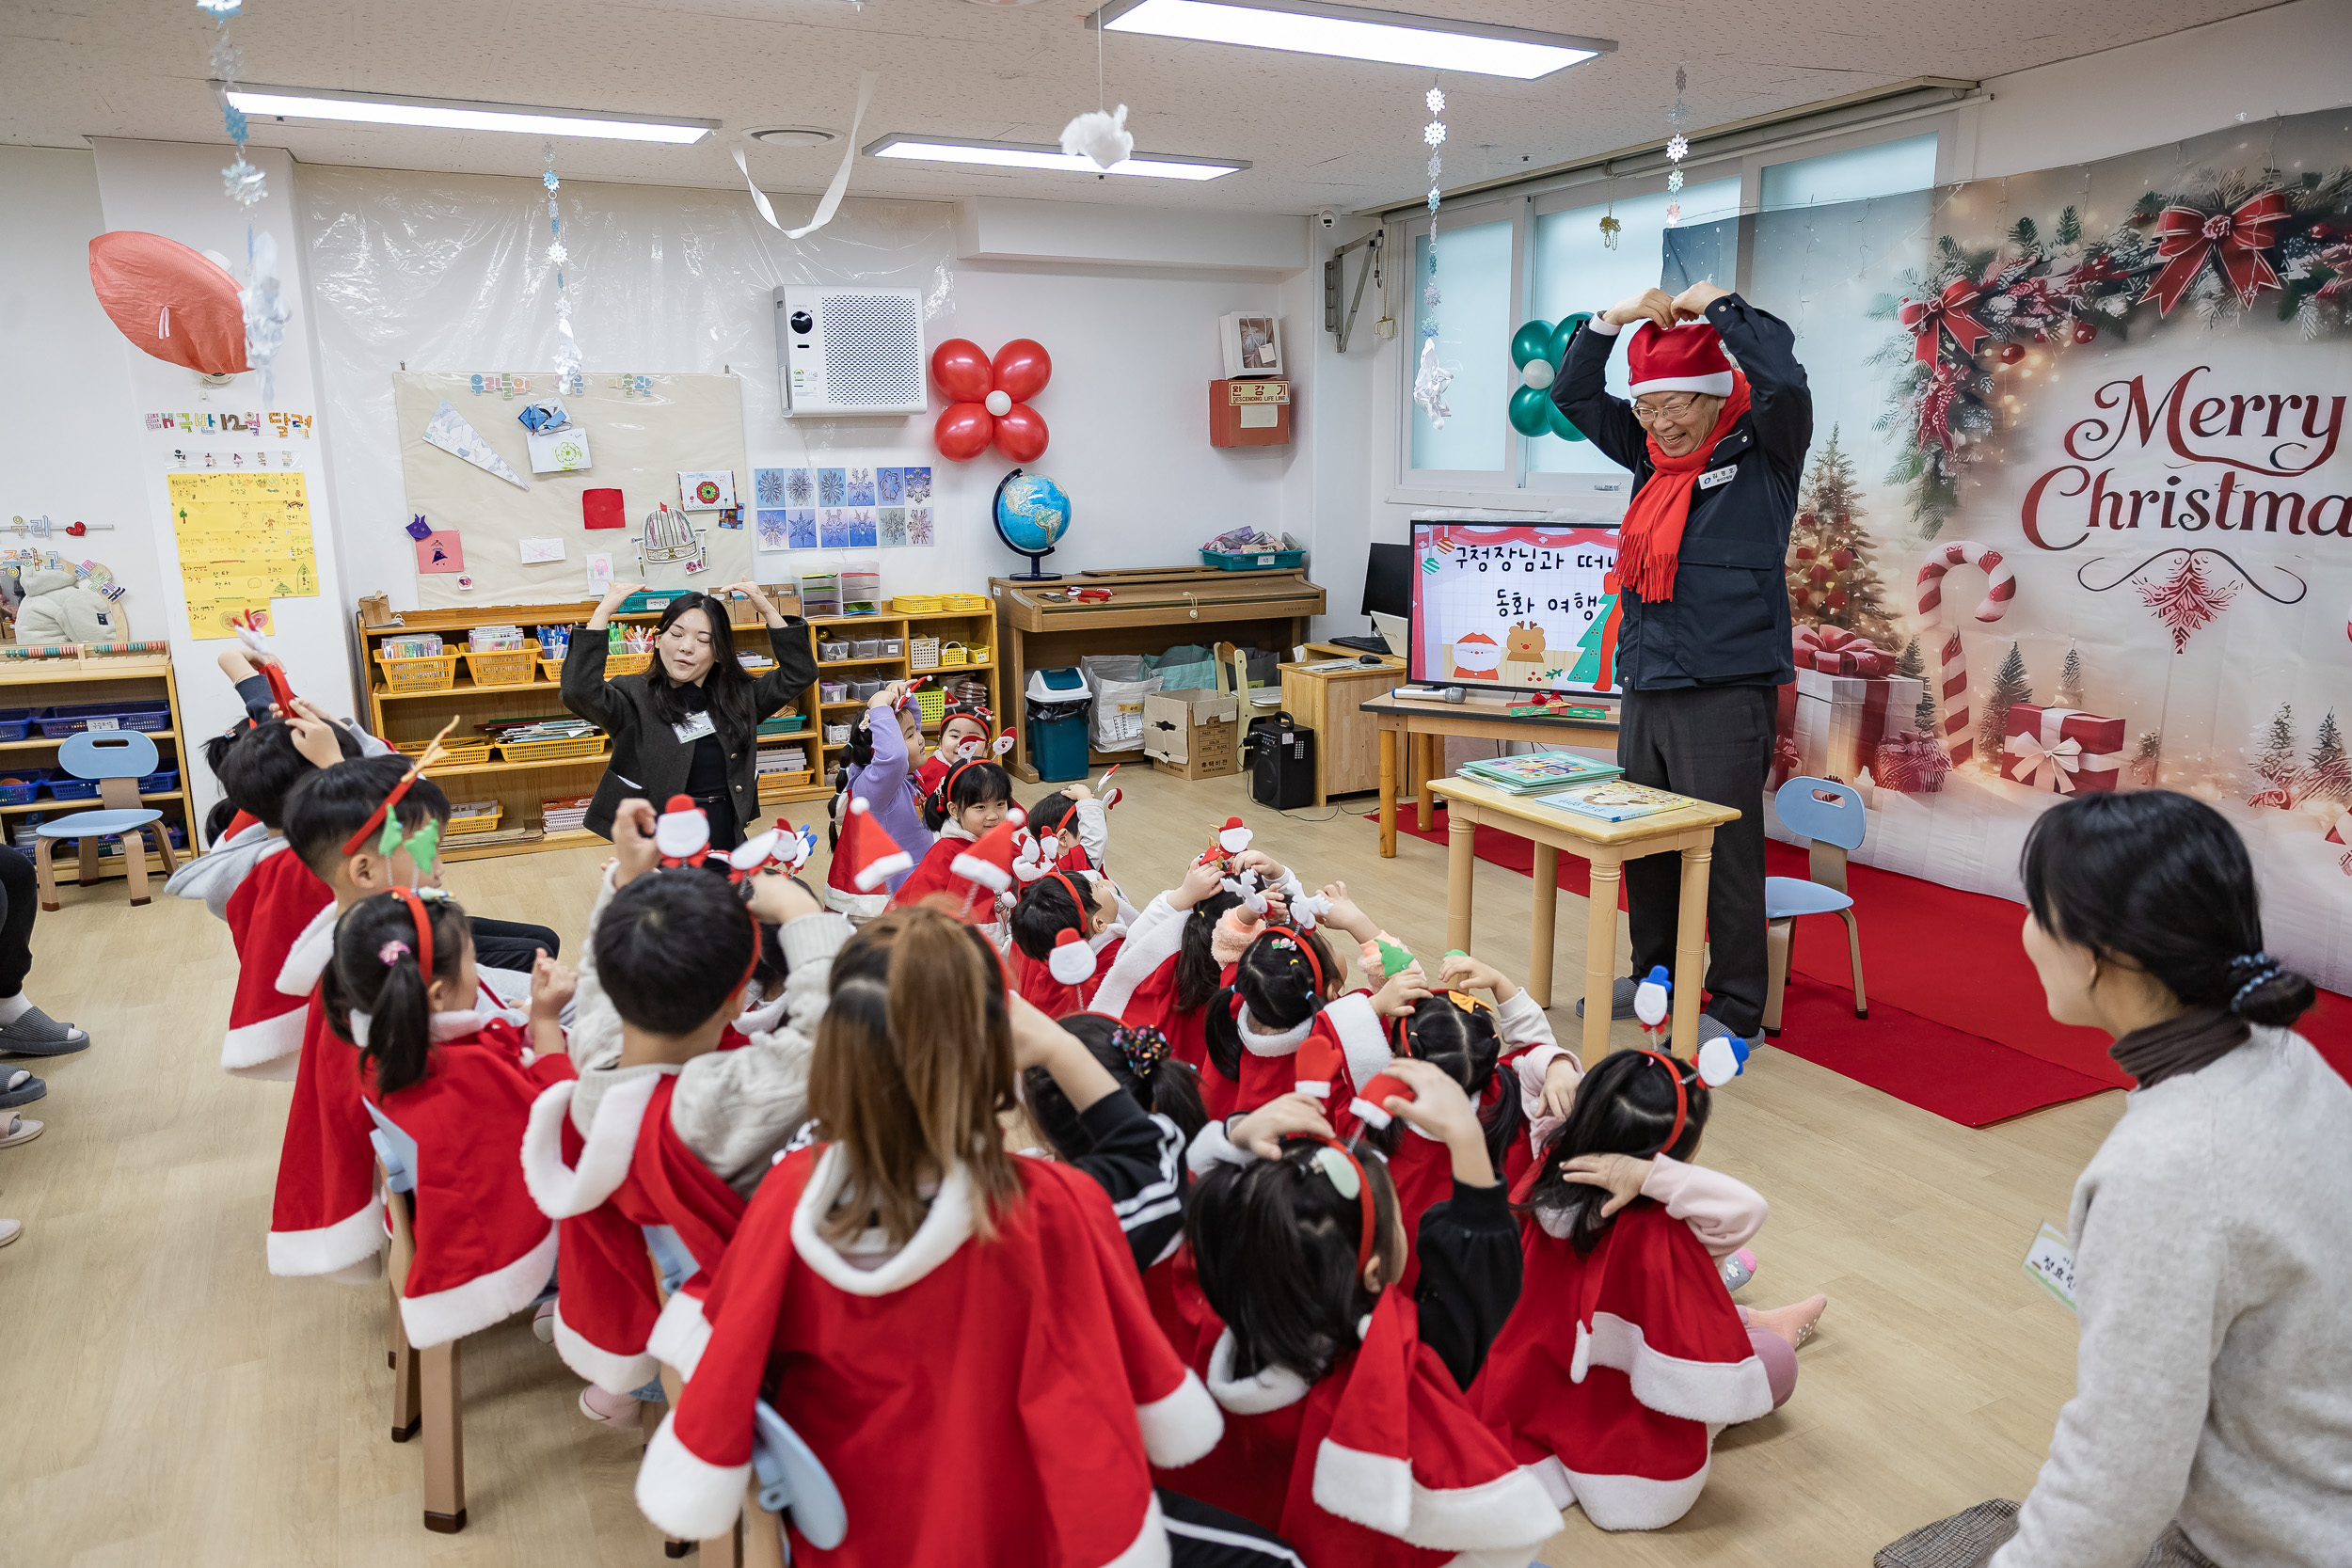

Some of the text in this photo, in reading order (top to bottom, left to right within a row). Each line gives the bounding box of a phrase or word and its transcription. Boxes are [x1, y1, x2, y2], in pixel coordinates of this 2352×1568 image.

[470, 372, 652, 398] 우리들의 은 미술관
[1232, 385, 1286, 396] 완강기
[220, 413, 261, 436] 12월
[268, 413, 311, 437] 달력
[2064, 366, 2346, 477] Merry
[175, 450, 186, 467] 월
[205, 452, 216, 467] 화
[234, 453, 243, 467] 수
[11, 515, 50, 537] 우리
[0, 547, 64, 577] 중하고
[1455, 545, 1565, 573] 구청장님과
[1496, 589, 1597, 621] 동화 여행
